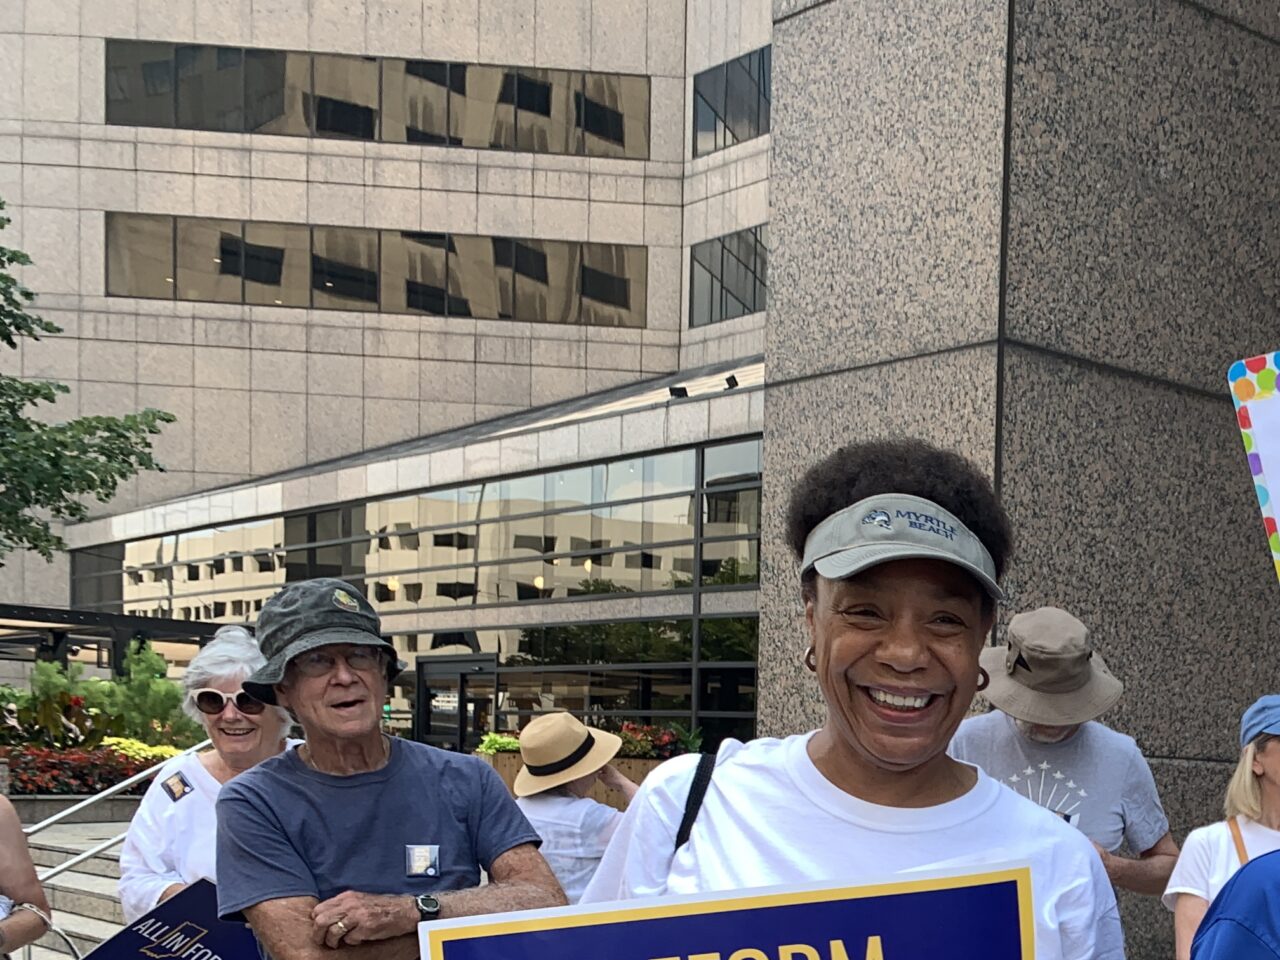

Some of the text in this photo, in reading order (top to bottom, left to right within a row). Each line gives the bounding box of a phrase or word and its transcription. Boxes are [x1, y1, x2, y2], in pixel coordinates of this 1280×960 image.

[895, 510, 958, 536] MYRTLE
[908, 521, 954, 541] BEACH
[132, 918, 170, 942] ALL
[160, 932, 190, 952] IN
